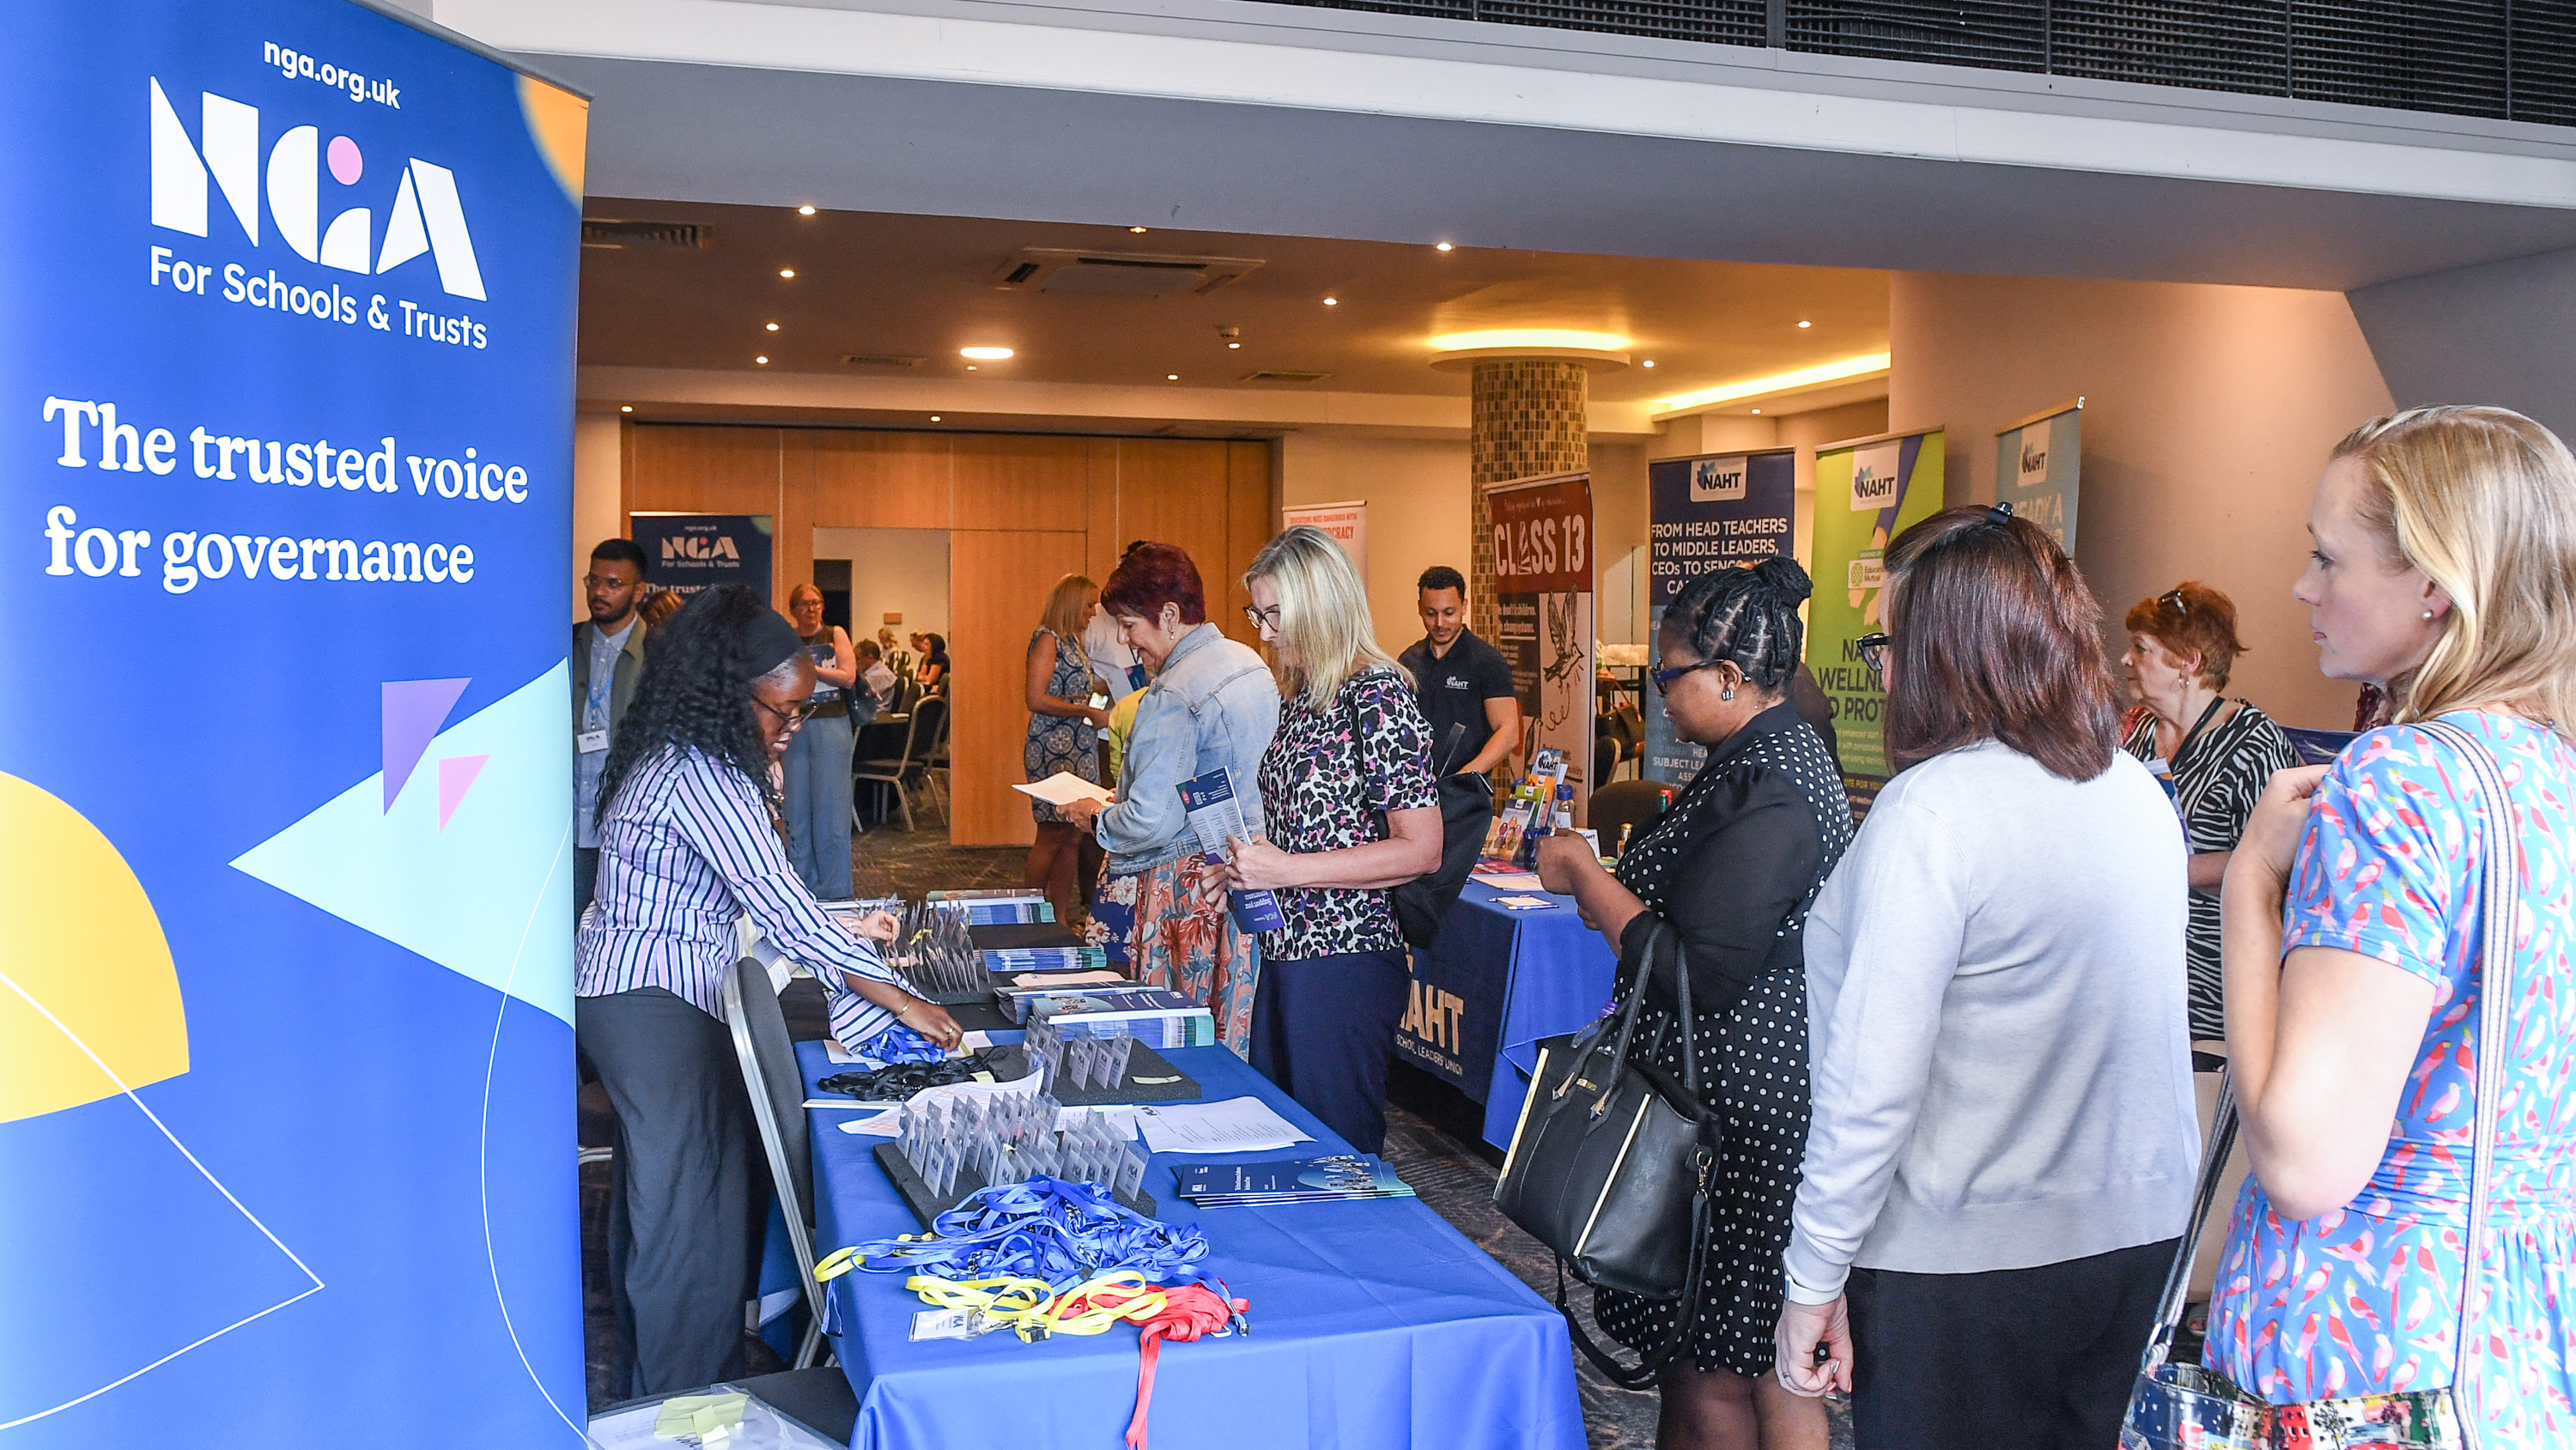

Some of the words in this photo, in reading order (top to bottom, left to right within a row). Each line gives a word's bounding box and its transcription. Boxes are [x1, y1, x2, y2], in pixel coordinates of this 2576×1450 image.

[264, 40, 401, 111] nga.org.uk
[150, 76, 488, 301] NGA
[150, 246, 211, 296] For
[222, 263, 357, 325] Schools
[368, 294, 391, 331] &
[398, 300, 488, 350] Trusts
[43, 395, 176, 476] The
[190, 425, 398, 494] trusted
[407, 447, 529, 504] voice
[1703, 472, 1741, 490] NAHT
[1860, 476, 1895, 498] NAHT
[1651, 523, 1683, 537] FROM
[1686, 521, 1720, 537] HEAD
[1722, 518, 1788, 536] TEACHERS
[45, 506, 150, 578] for
[163, 528, 476, 594] governance
[662, 537, 740, 559] NGA
[1494, 518, 1557, 576] CLASS
[1562, 514, 1585, 573] 13
[1654, 542, 1669, 556] TO
[1672, 540, 1718, 556] MIDDLE
[1721, 538, 1779, 555] LEADERS,
[1651, 561, 1680, 575] CEOs
[1684, 561, 1701, 575] TO
[646, 583, 667, 593] The
[1653, 756, 1689, 768] SUBJECT
[1856, 780, 1868, 788] FOR
[1400, 979, 1464, 1055] AHT
